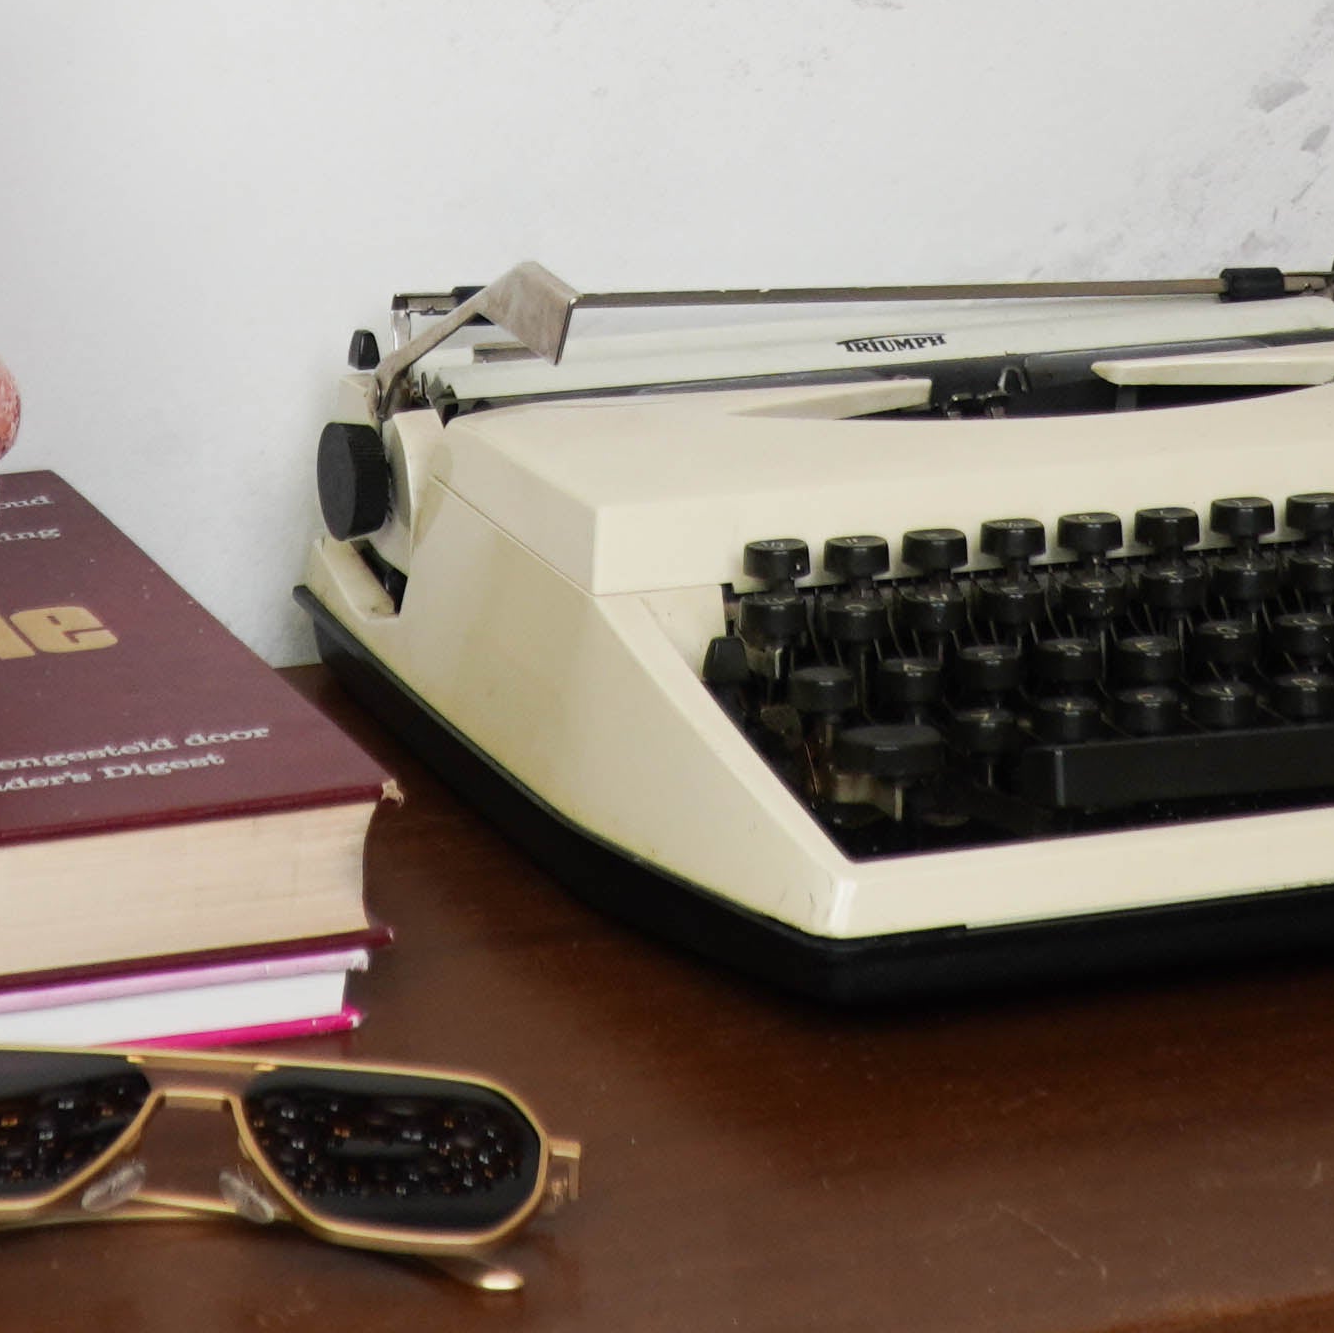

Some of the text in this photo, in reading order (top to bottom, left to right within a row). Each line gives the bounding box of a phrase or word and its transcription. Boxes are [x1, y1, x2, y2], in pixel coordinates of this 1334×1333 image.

[836, 332, 947, 353] TRIUMPH
[184, 727, 270, 748] door
[97, 752, 226, 780] Digest
